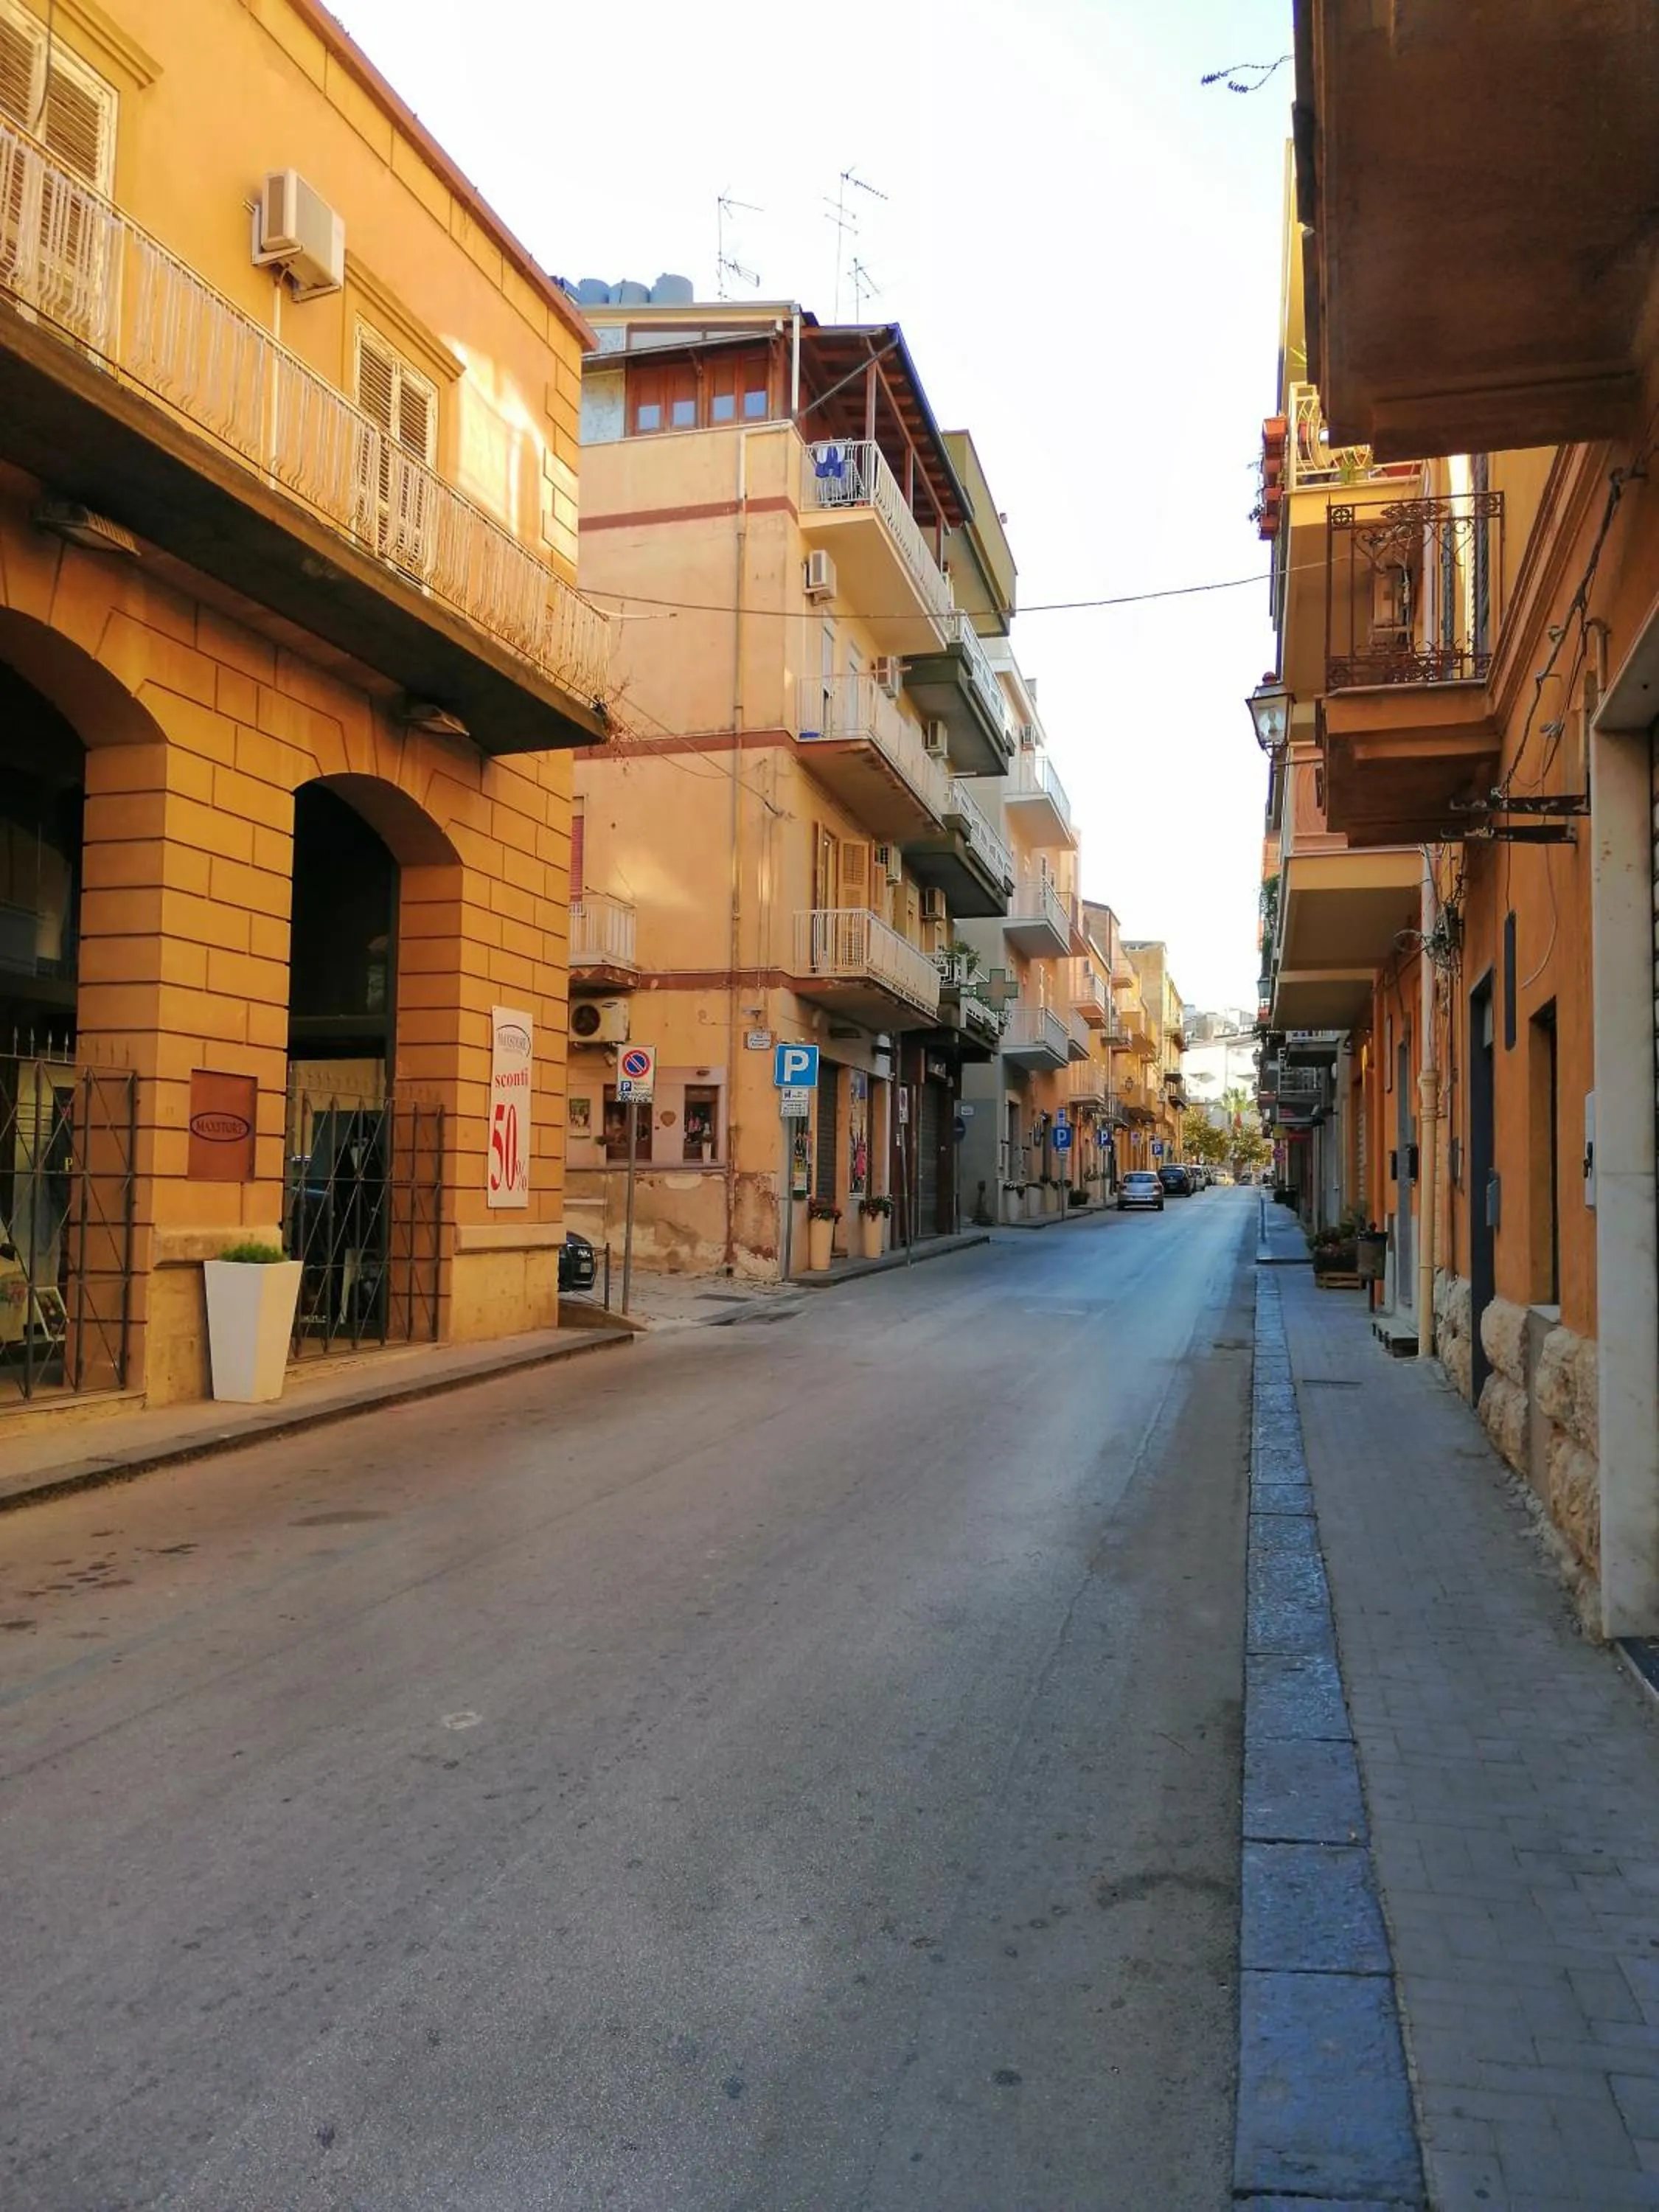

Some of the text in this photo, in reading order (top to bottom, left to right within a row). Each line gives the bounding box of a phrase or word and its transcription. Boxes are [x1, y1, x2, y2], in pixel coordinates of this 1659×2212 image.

[784, 1049, 809, 1082] P
[495, 1066, 529, 1089] sconti
[622, 1081, 630, 1091] P
[1057, 1129, 1067, 1146] P
[1101, 1130, 1108, 1144] P
